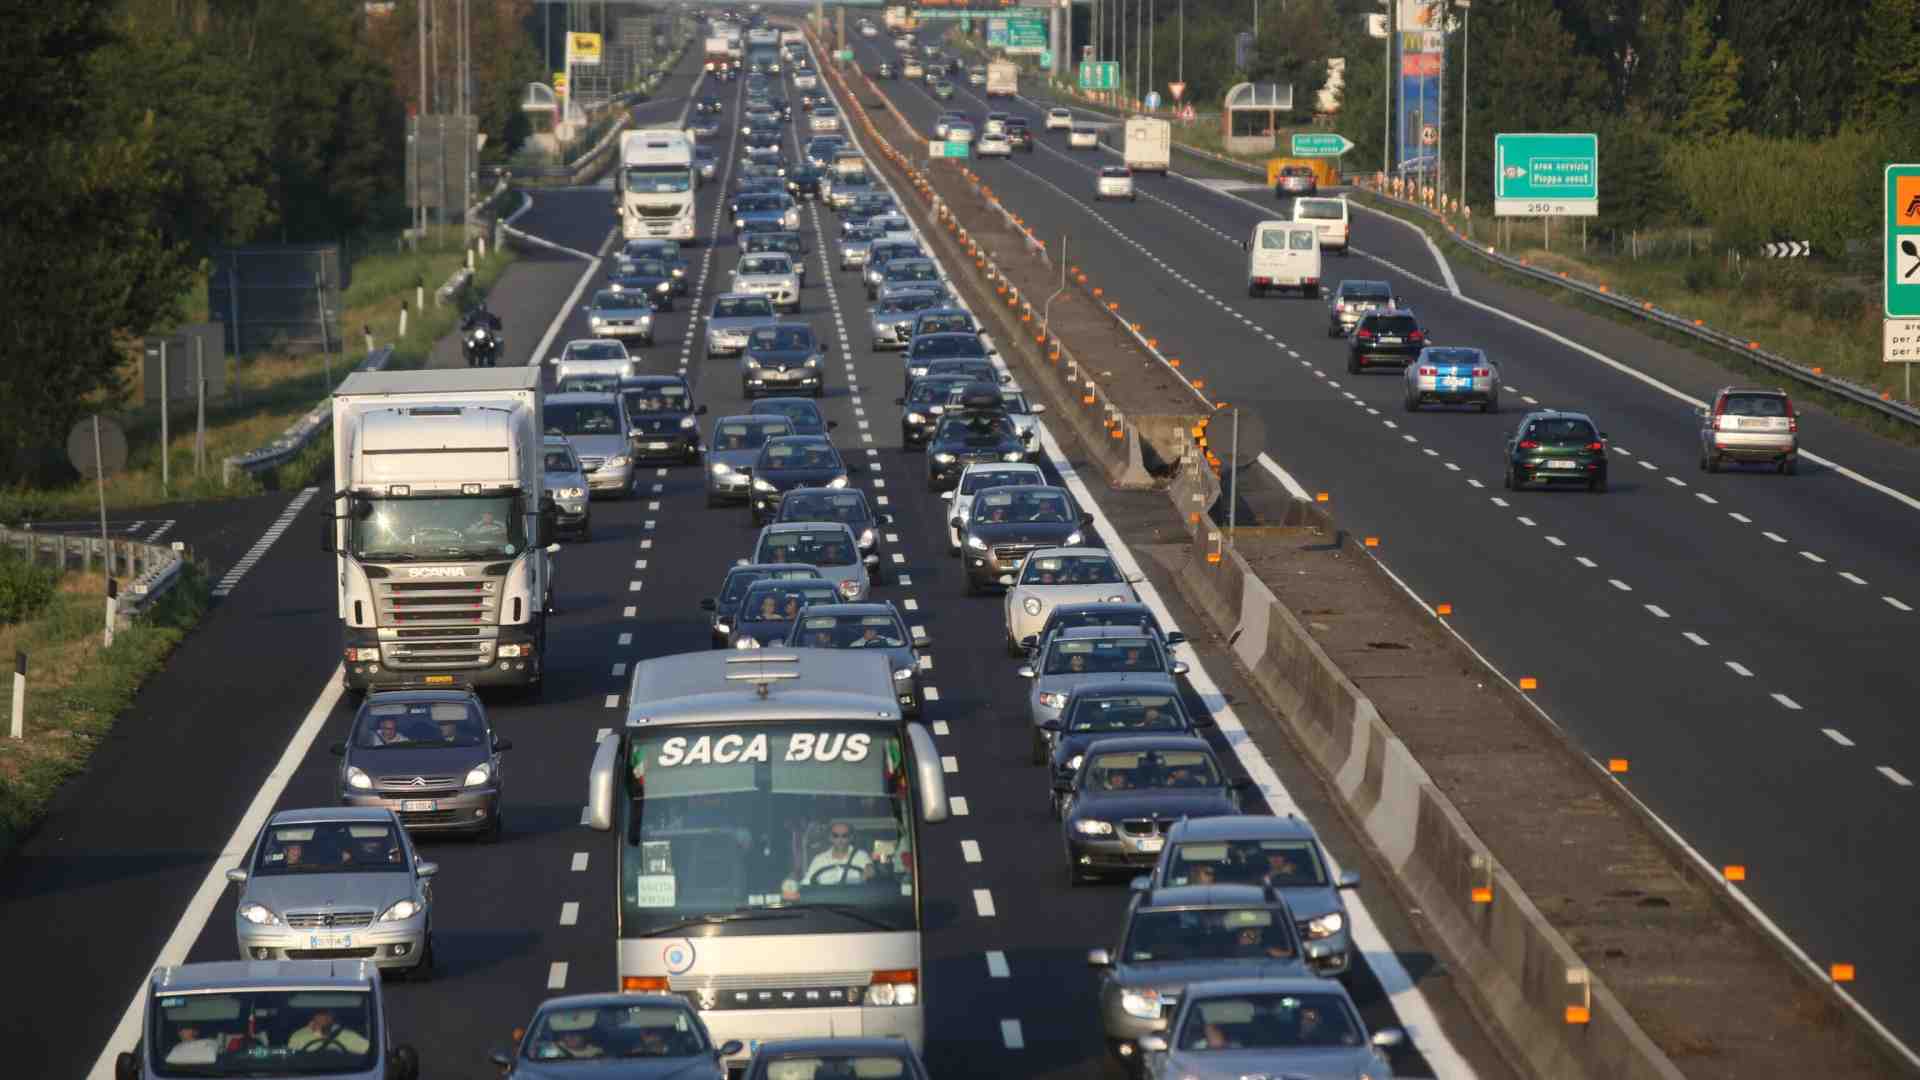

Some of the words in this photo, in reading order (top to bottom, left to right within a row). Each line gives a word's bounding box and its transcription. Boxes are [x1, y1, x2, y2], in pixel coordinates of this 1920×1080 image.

[1556, 161, 1589, 170] servizio
[1528, 203, 1550, 212] 250
[407, 567, 466, 577] SCANIA
[658, 734, 769, 767] SACA
[784, 733, 872, 762] BUS
